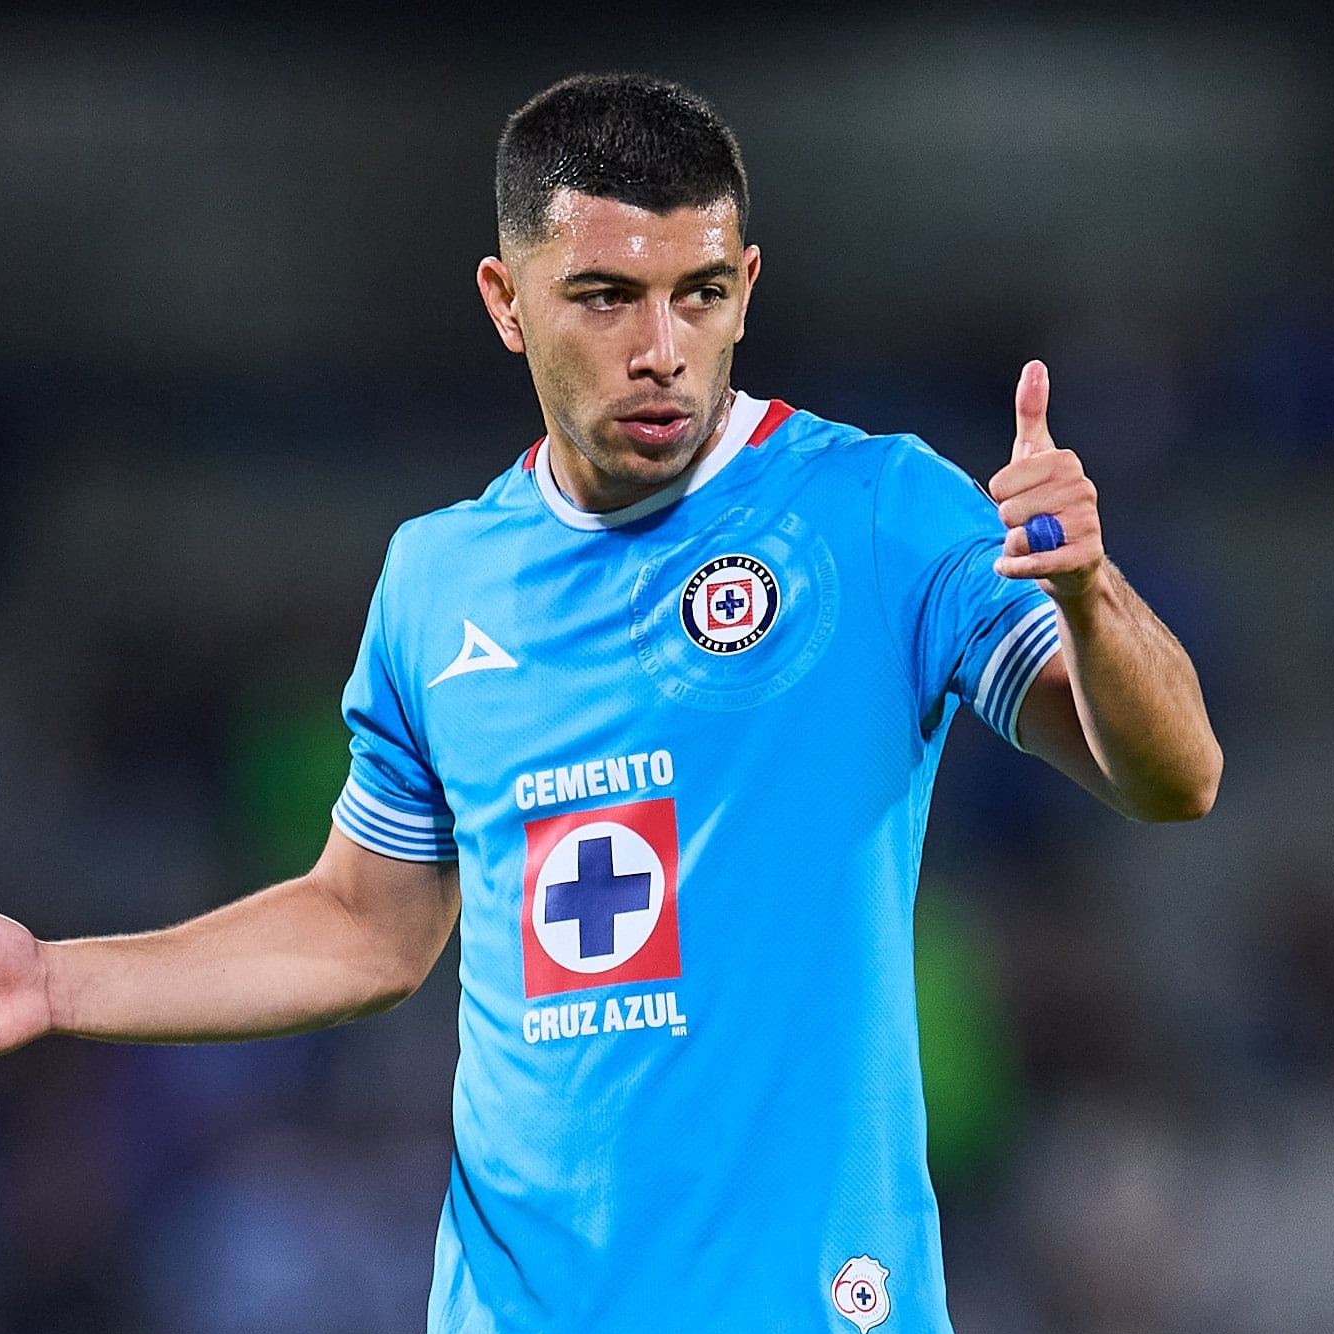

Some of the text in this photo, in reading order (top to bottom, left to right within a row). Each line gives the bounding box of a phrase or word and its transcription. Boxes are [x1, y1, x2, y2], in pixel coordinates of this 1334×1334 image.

[685, 570, 707, 600] CLUB
[713, 559, 727, 570] DE
[698, 628, 763, 651] CRUZ AZUL
[515, 749, 674, 810] CEMENTO
[522, 992, 686, 1044] CRUZ AZUL
[671, 1026, 688, 1037] MR
